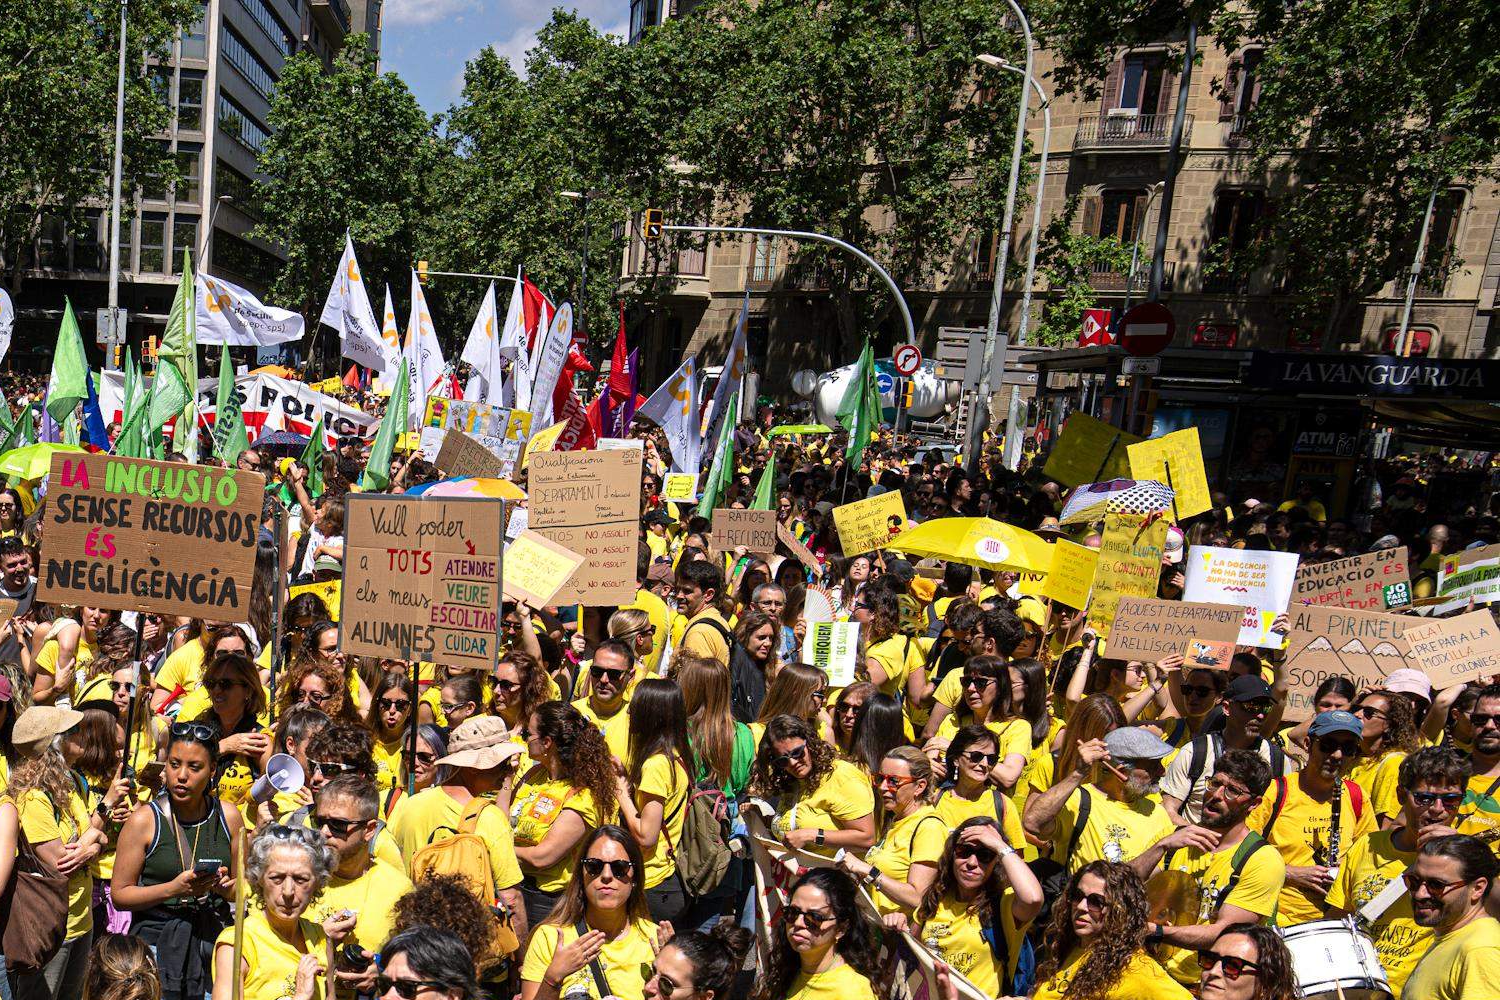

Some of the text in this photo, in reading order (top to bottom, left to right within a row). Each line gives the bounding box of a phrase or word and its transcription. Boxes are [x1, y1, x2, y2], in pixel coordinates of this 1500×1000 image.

[1300, 432, 1334, 446] ATM
[61, 458, 238, 506] LA INCLUSIÓ
[534, 484, 602, 504] DEPARTAMENT
[54, 493, 257, 547] SENSE RECURSOS
[370, 504, 465, 548] Vull poder
[84, 527, 117, 559] ÉS
[585, 530, 599, 540] NO
[601, 529, 632, 538] ASSOLIT
[585, 546, 630, 555] NO ASSOLIT
[1376, 548, 1397, 562] EN
[360, 548, 433, 575] a TOTS
[444, 559, 496, 578] ATENDRE
[1213, 558, 1227, 568] LA
[46, 556, 239, 608] NEGLIGÈNCIA
[601, 580, 627, 588] ASSOLIT
[1211, 568, 1266, 580] NO HA DE SER
[1298, 561, 1404, 593] EDUCACIÓ ÉS
[356, 579, 432, 609] els meus
[447, 583, 490, 605] VEURE
[1365, 580, 1383, 593] EN
[1386, 582, 1406, 595] JO
[1386, 591, 1408, 602] FAIG
[1387, 597, 1408, 606] VAGA
[431, 606, 497, 631] ESCOLTAR
[1120, 602, 1162, 617] AQUEST
[1167, 605, 1241, 623] DEPARTAMENT
[1294, 612, 1313, 632] AL
[351, 620, 436, 653] ALUMNES
[1114, 617, 1198, 637] ÉS CAN PIXA
[445, 632, 487, 656] CUIDAR
[814, 625, 832, 668] GNIFIQUEM
